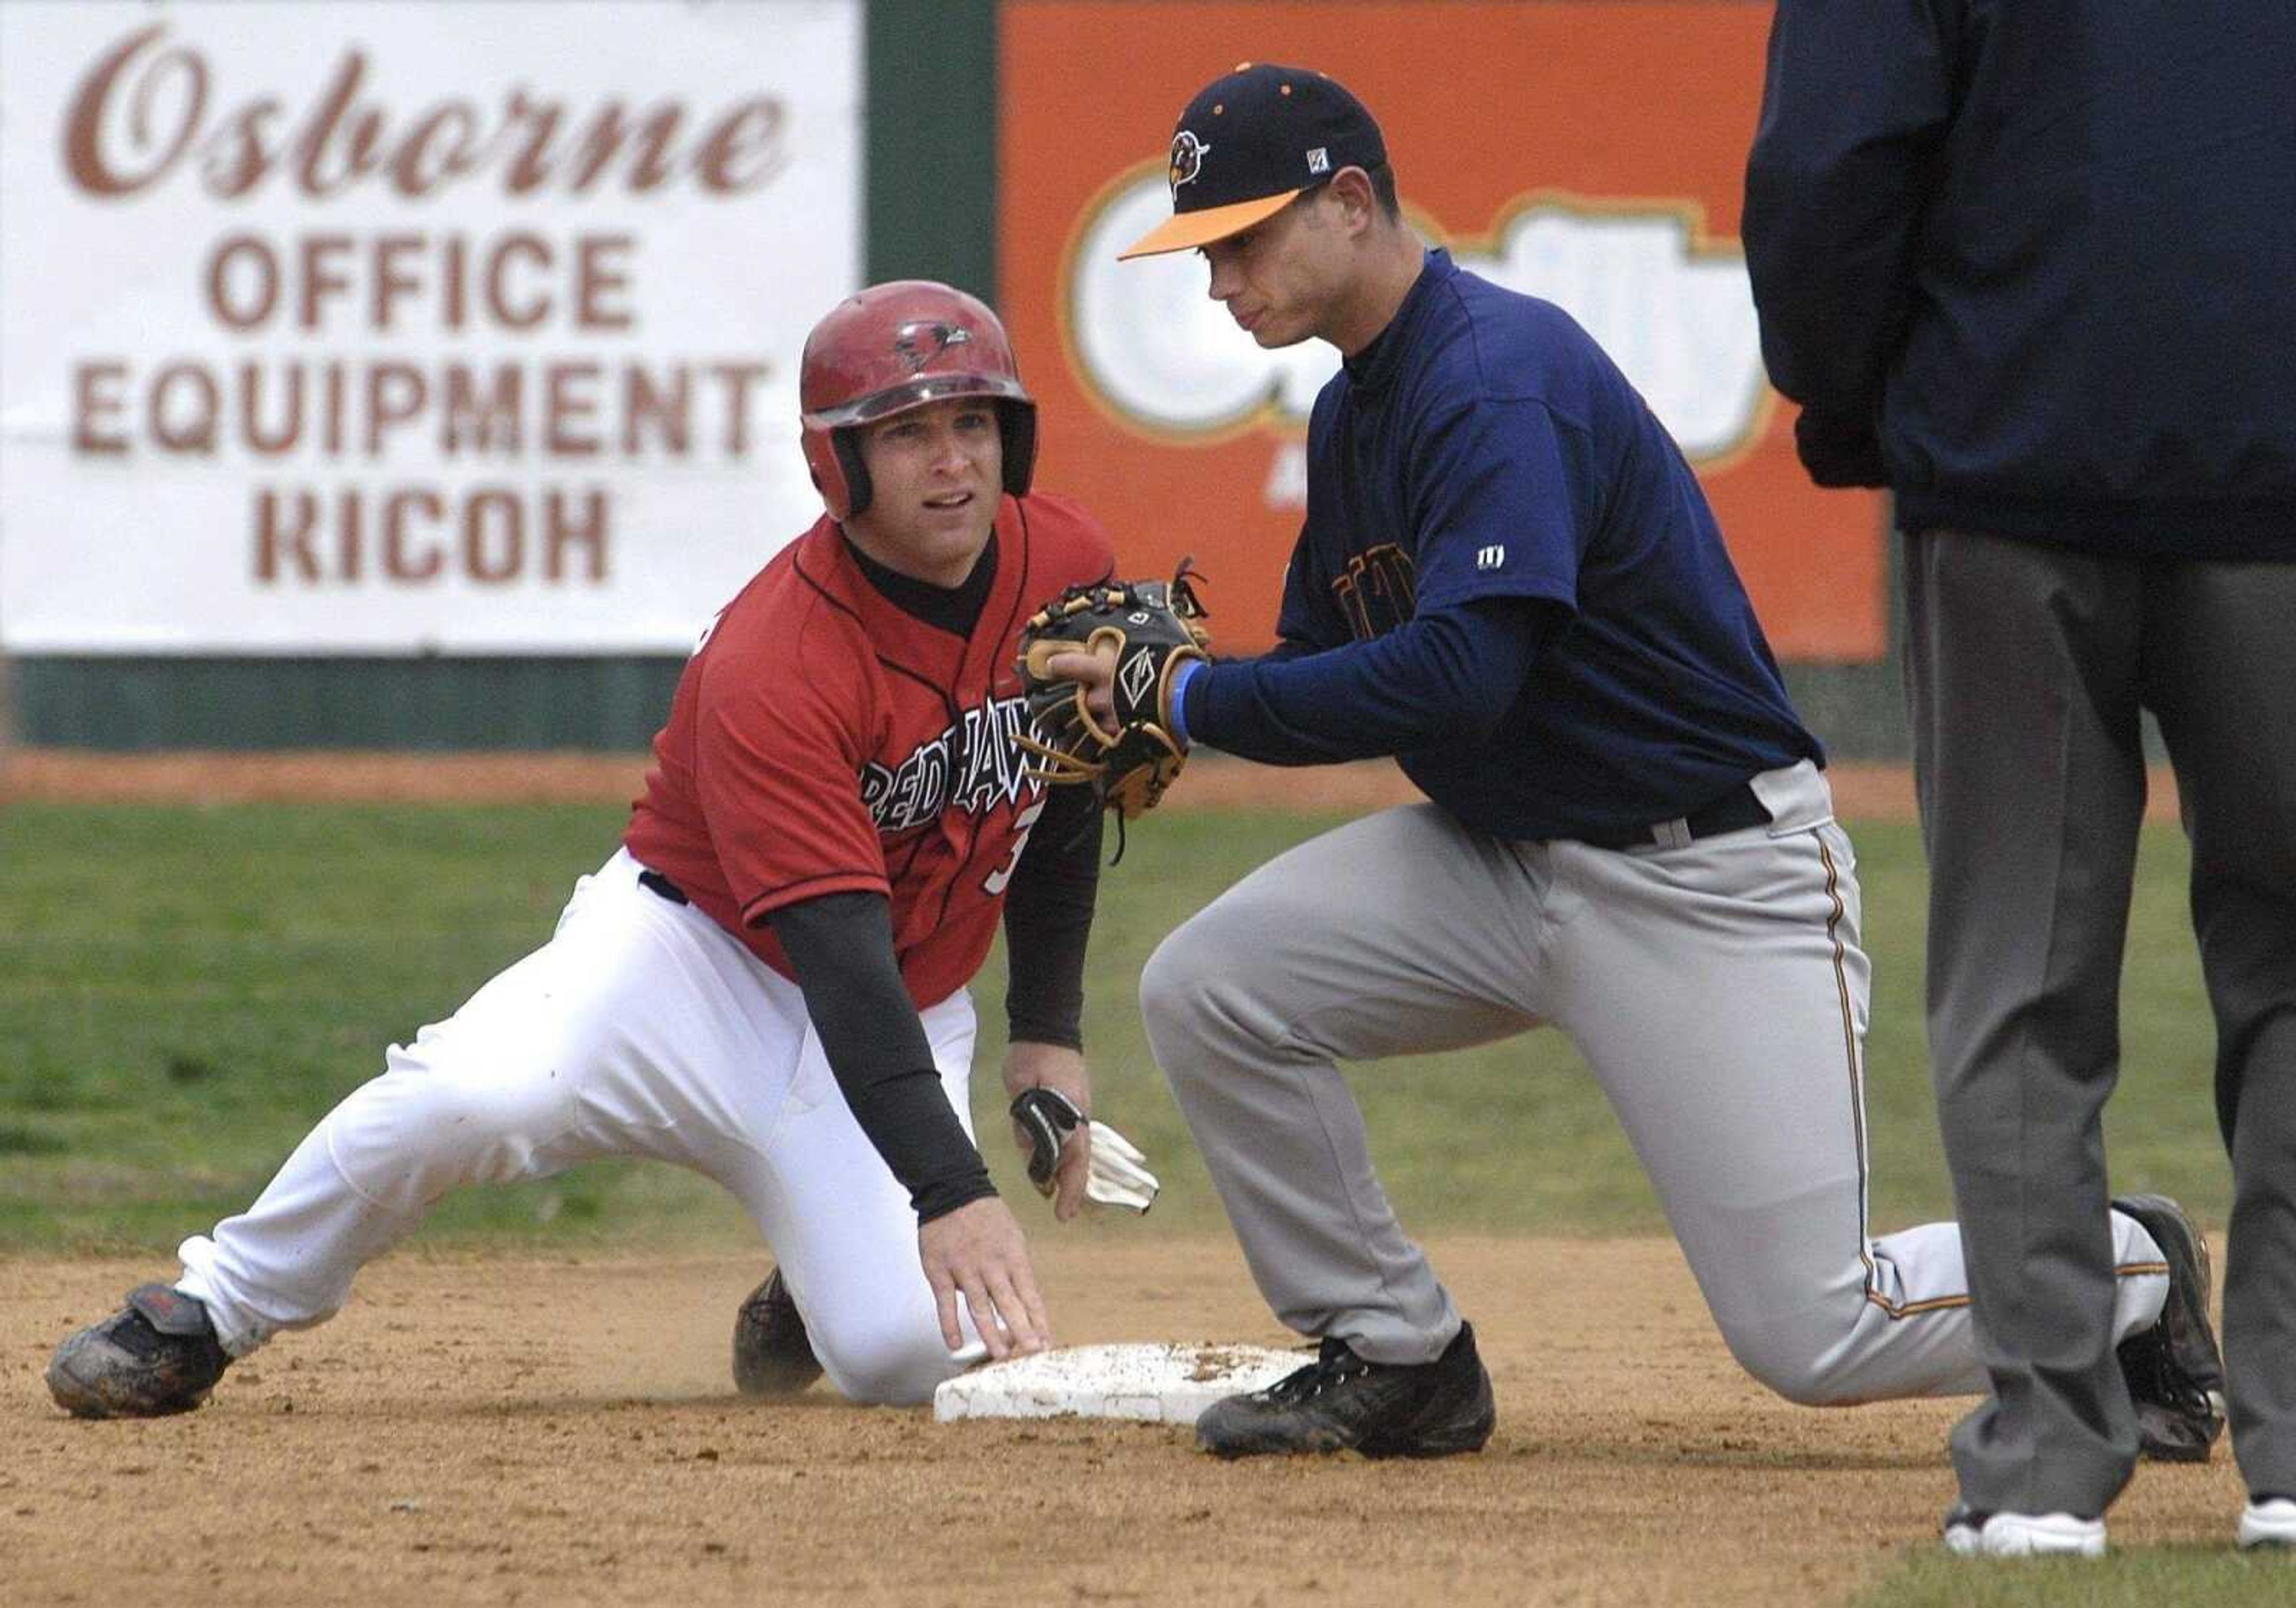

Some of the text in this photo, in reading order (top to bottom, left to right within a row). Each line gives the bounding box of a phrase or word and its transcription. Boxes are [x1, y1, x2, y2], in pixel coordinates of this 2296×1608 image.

[60, 23, 790, 200] Osborne
[206, 232, 635, 332] OFFICE
[72, 362, 773, 457] EQUIPMENT
